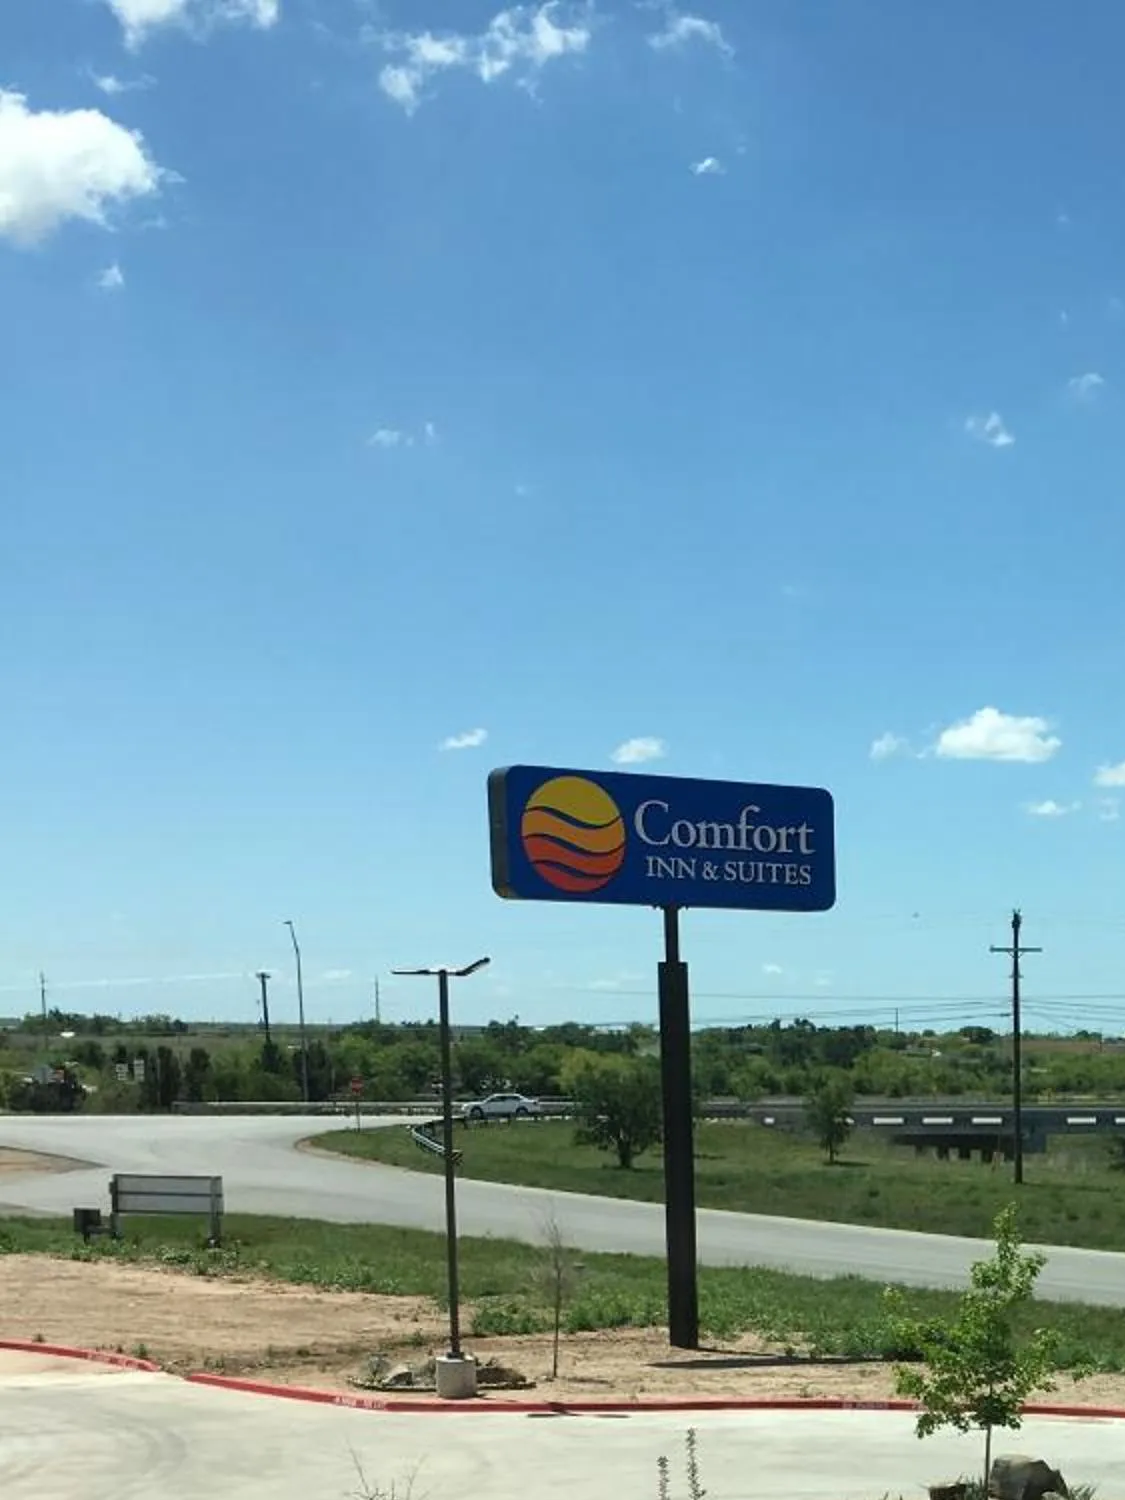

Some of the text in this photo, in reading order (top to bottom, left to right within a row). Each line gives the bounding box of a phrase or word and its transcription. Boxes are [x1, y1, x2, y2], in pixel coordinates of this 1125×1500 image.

[633, 799, 815, 855] Comfort
[646, 855, 812, 885] INN & SUITES
